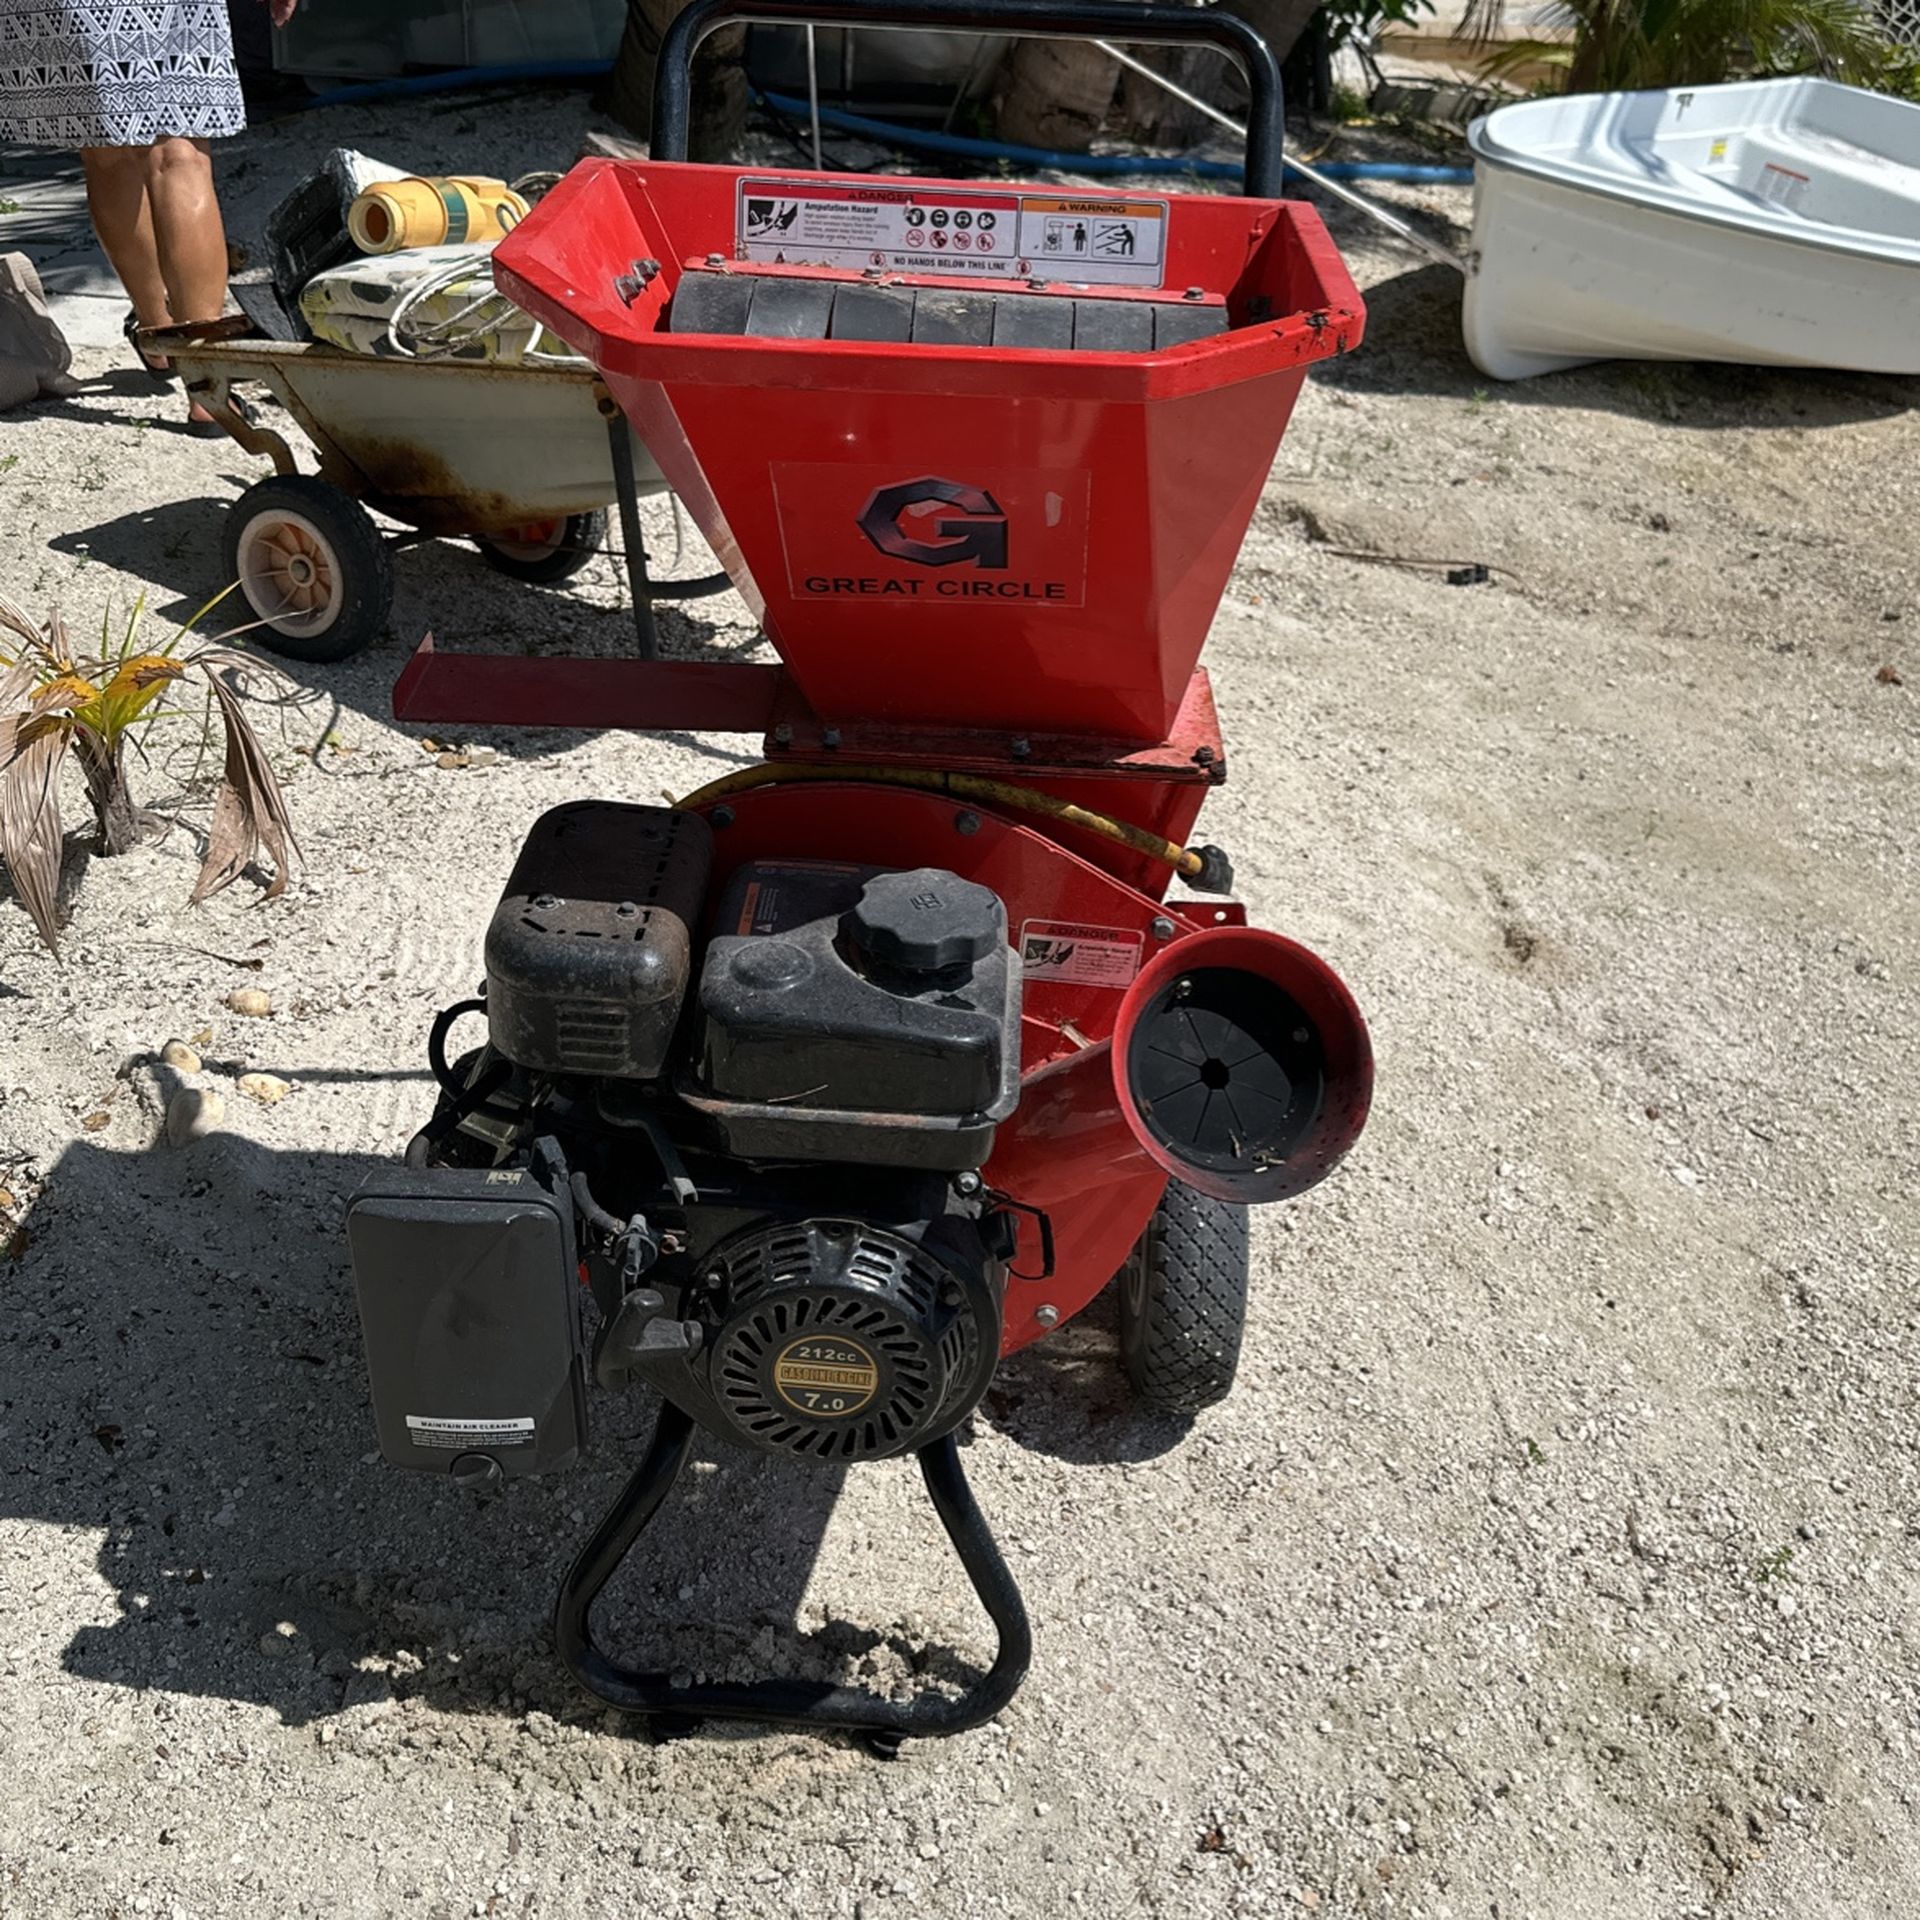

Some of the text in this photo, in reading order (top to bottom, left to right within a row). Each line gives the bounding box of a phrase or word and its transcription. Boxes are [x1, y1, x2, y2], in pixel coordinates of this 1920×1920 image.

[858, 191, 914, 203] DANGER
[804, 202, 878, 214] Amputation Hazard
[1069, 203, 1127, 213] WARNING
[894, 257, 1006, 271] NO HANDS BELOW THIS LINE
[805, 576, 1066, 599] GREAT CIRCLE
[1059, 926, 1119, 940] DANGER
[799, 1346, 857, 1363] 212cc
[804, 1392, 845, 1411] 7.0
[421, 1420, 461, 1430] MAINTAIN
[479, 1422, 519, 1430] CLEANER
